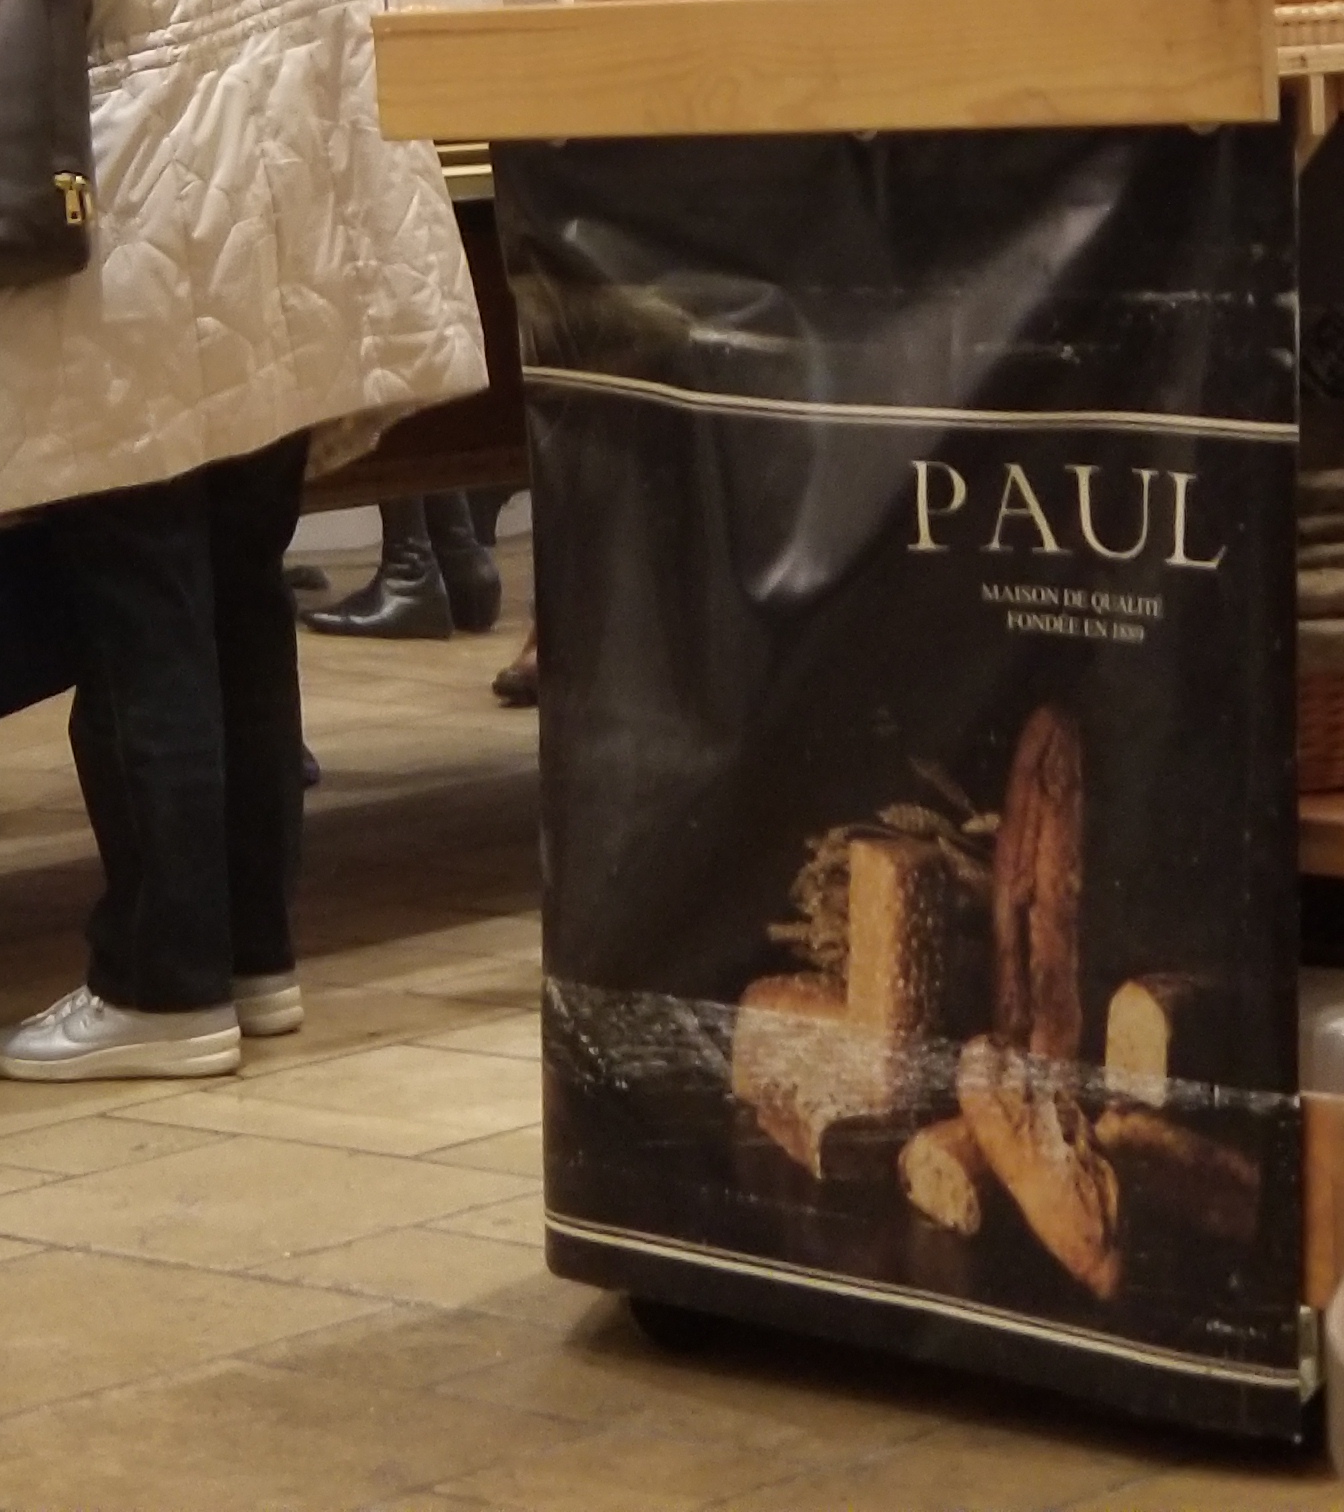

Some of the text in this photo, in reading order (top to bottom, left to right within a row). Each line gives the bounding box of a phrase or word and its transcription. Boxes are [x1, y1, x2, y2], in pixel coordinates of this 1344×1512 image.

[907, 459, 1228, 571] PAUL
[982, 582, 1060, 605] MAISON
[1063, 588, 1084, 608] DE
[1083, 617, 1108, 638] EN
